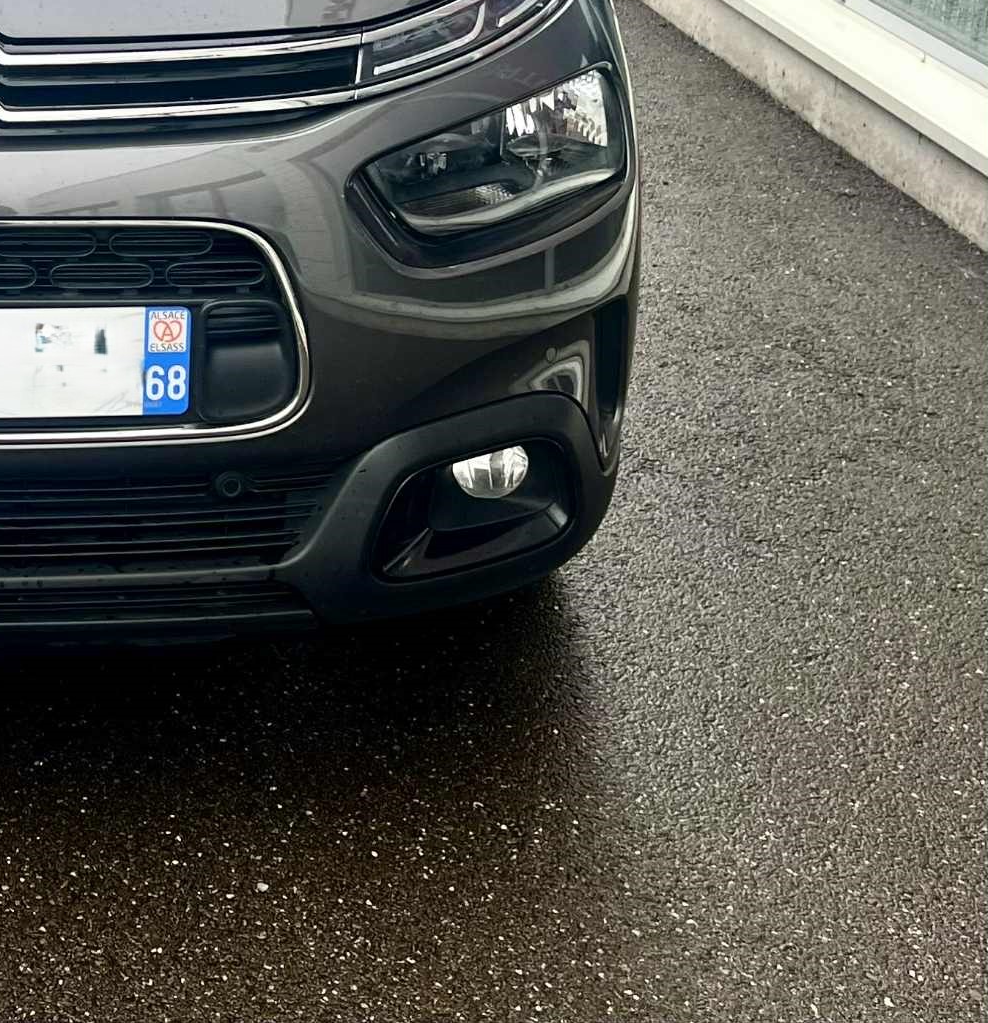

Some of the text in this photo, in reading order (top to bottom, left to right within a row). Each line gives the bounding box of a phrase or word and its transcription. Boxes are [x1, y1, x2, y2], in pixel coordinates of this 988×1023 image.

[150, 311, 185, 320] ALSACE
[150, 342, 185, 352] ELSASS
[146, 364, 187, 401] 68
